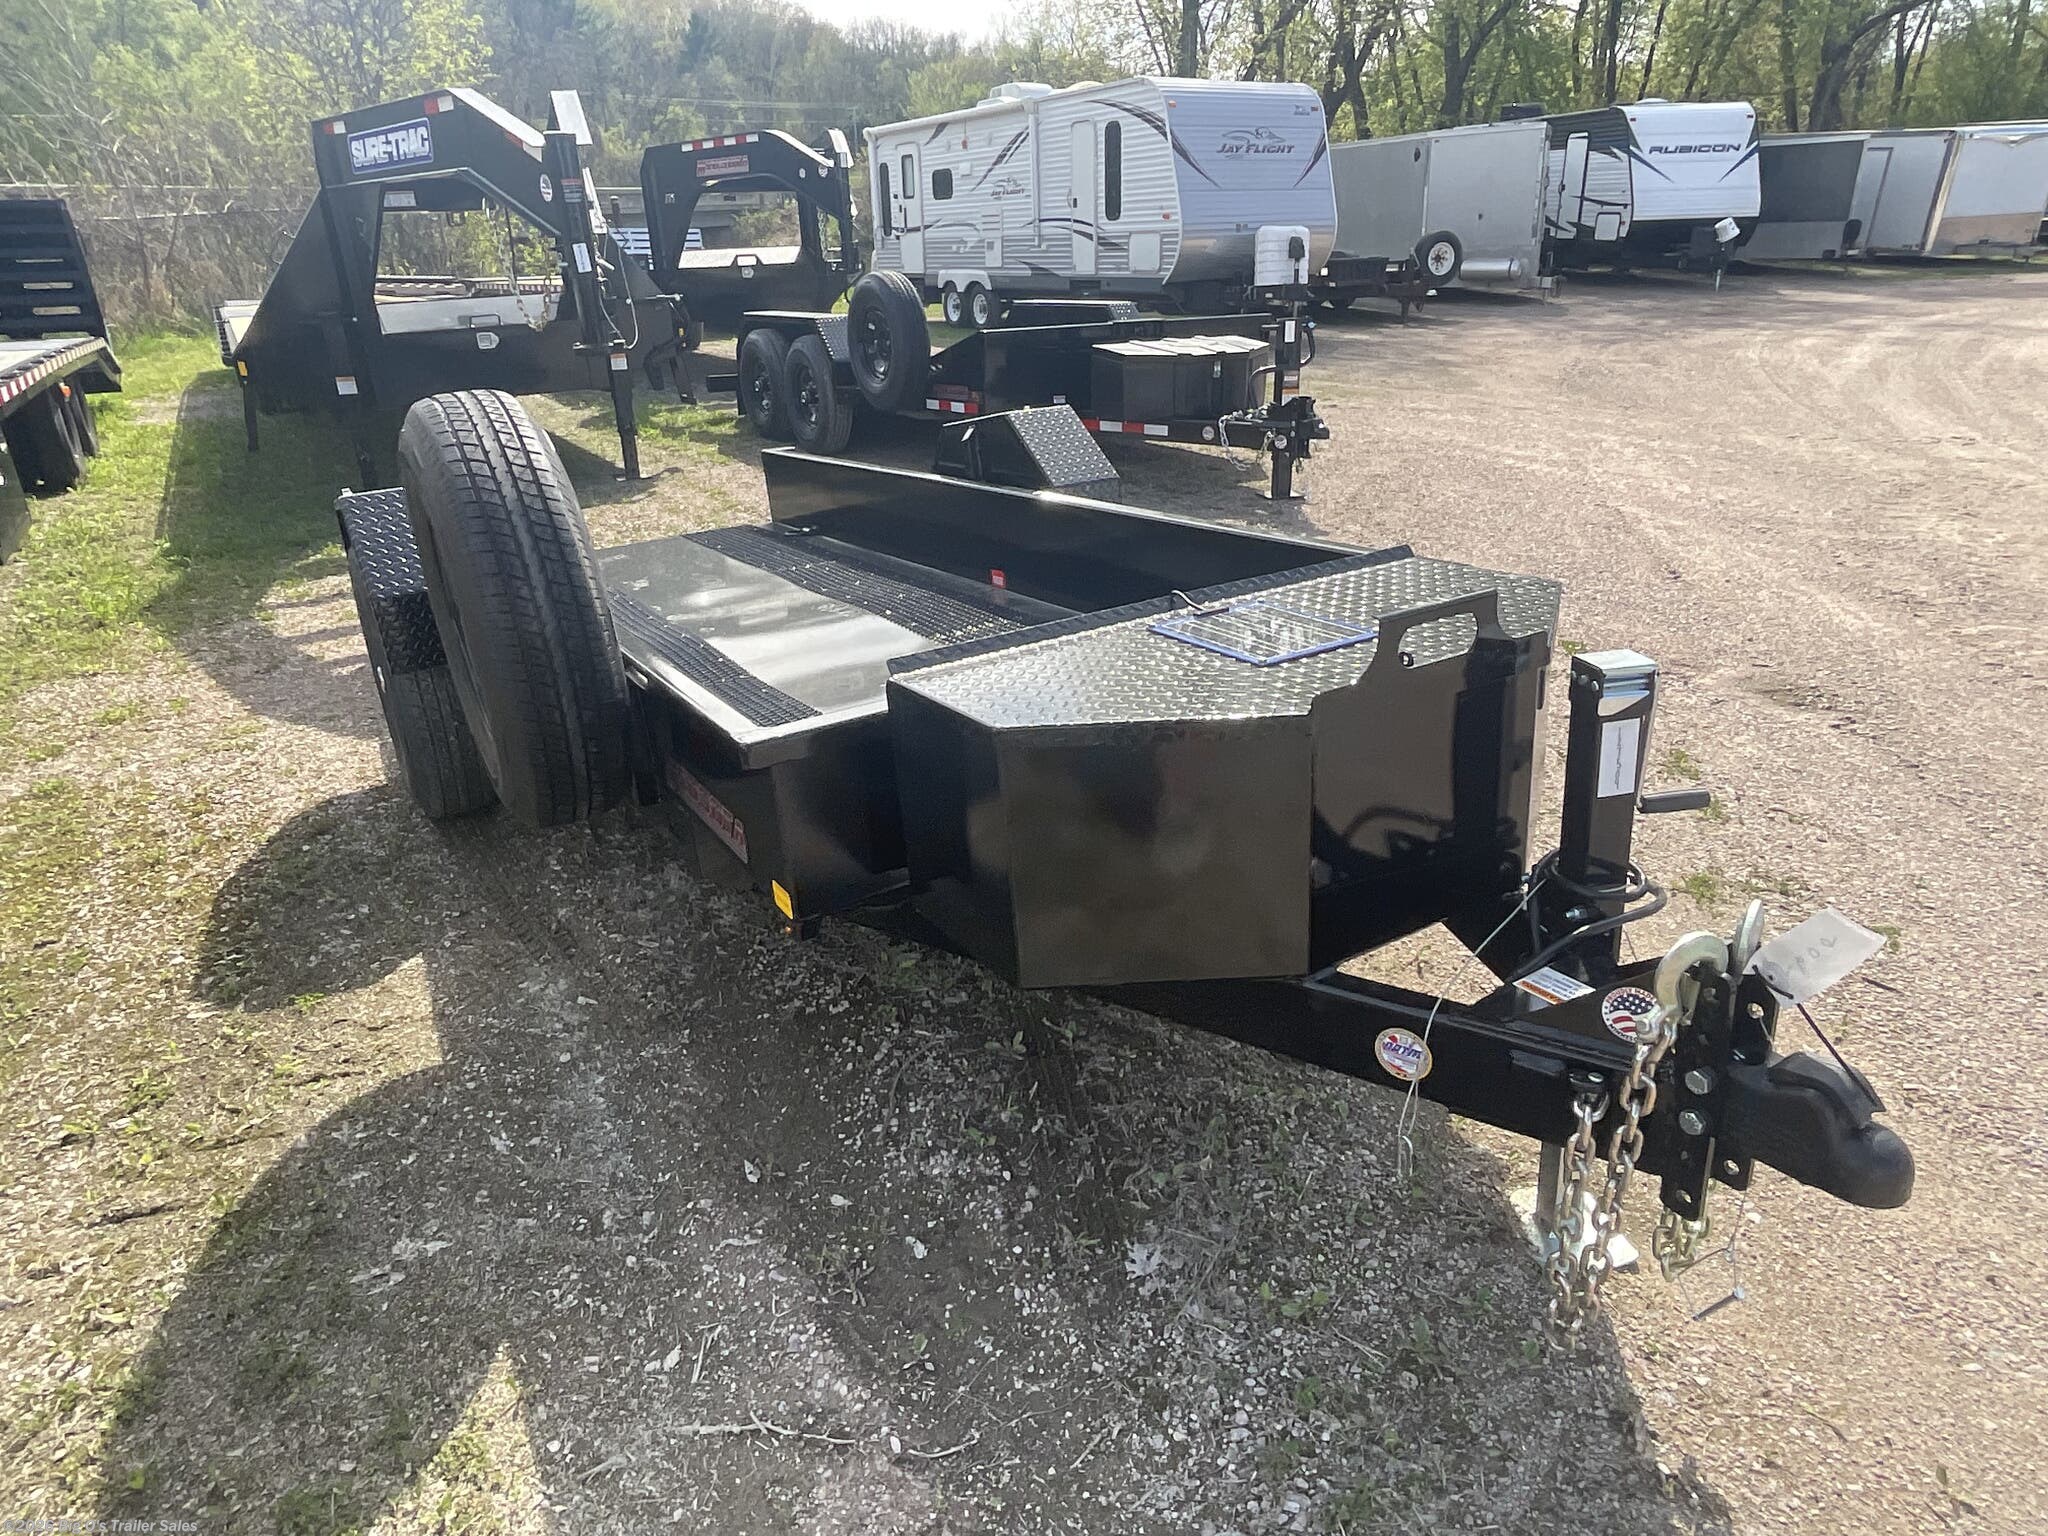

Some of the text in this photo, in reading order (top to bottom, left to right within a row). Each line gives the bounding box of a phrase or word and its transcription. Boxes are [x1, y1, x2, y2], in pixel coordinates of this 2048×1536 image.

[351, 126, 430, 168] SURE-TRAC
[1216, 143, 1295, 154] JAY FLIGHT
[1648, 144, 1742, 154] RUBICON
